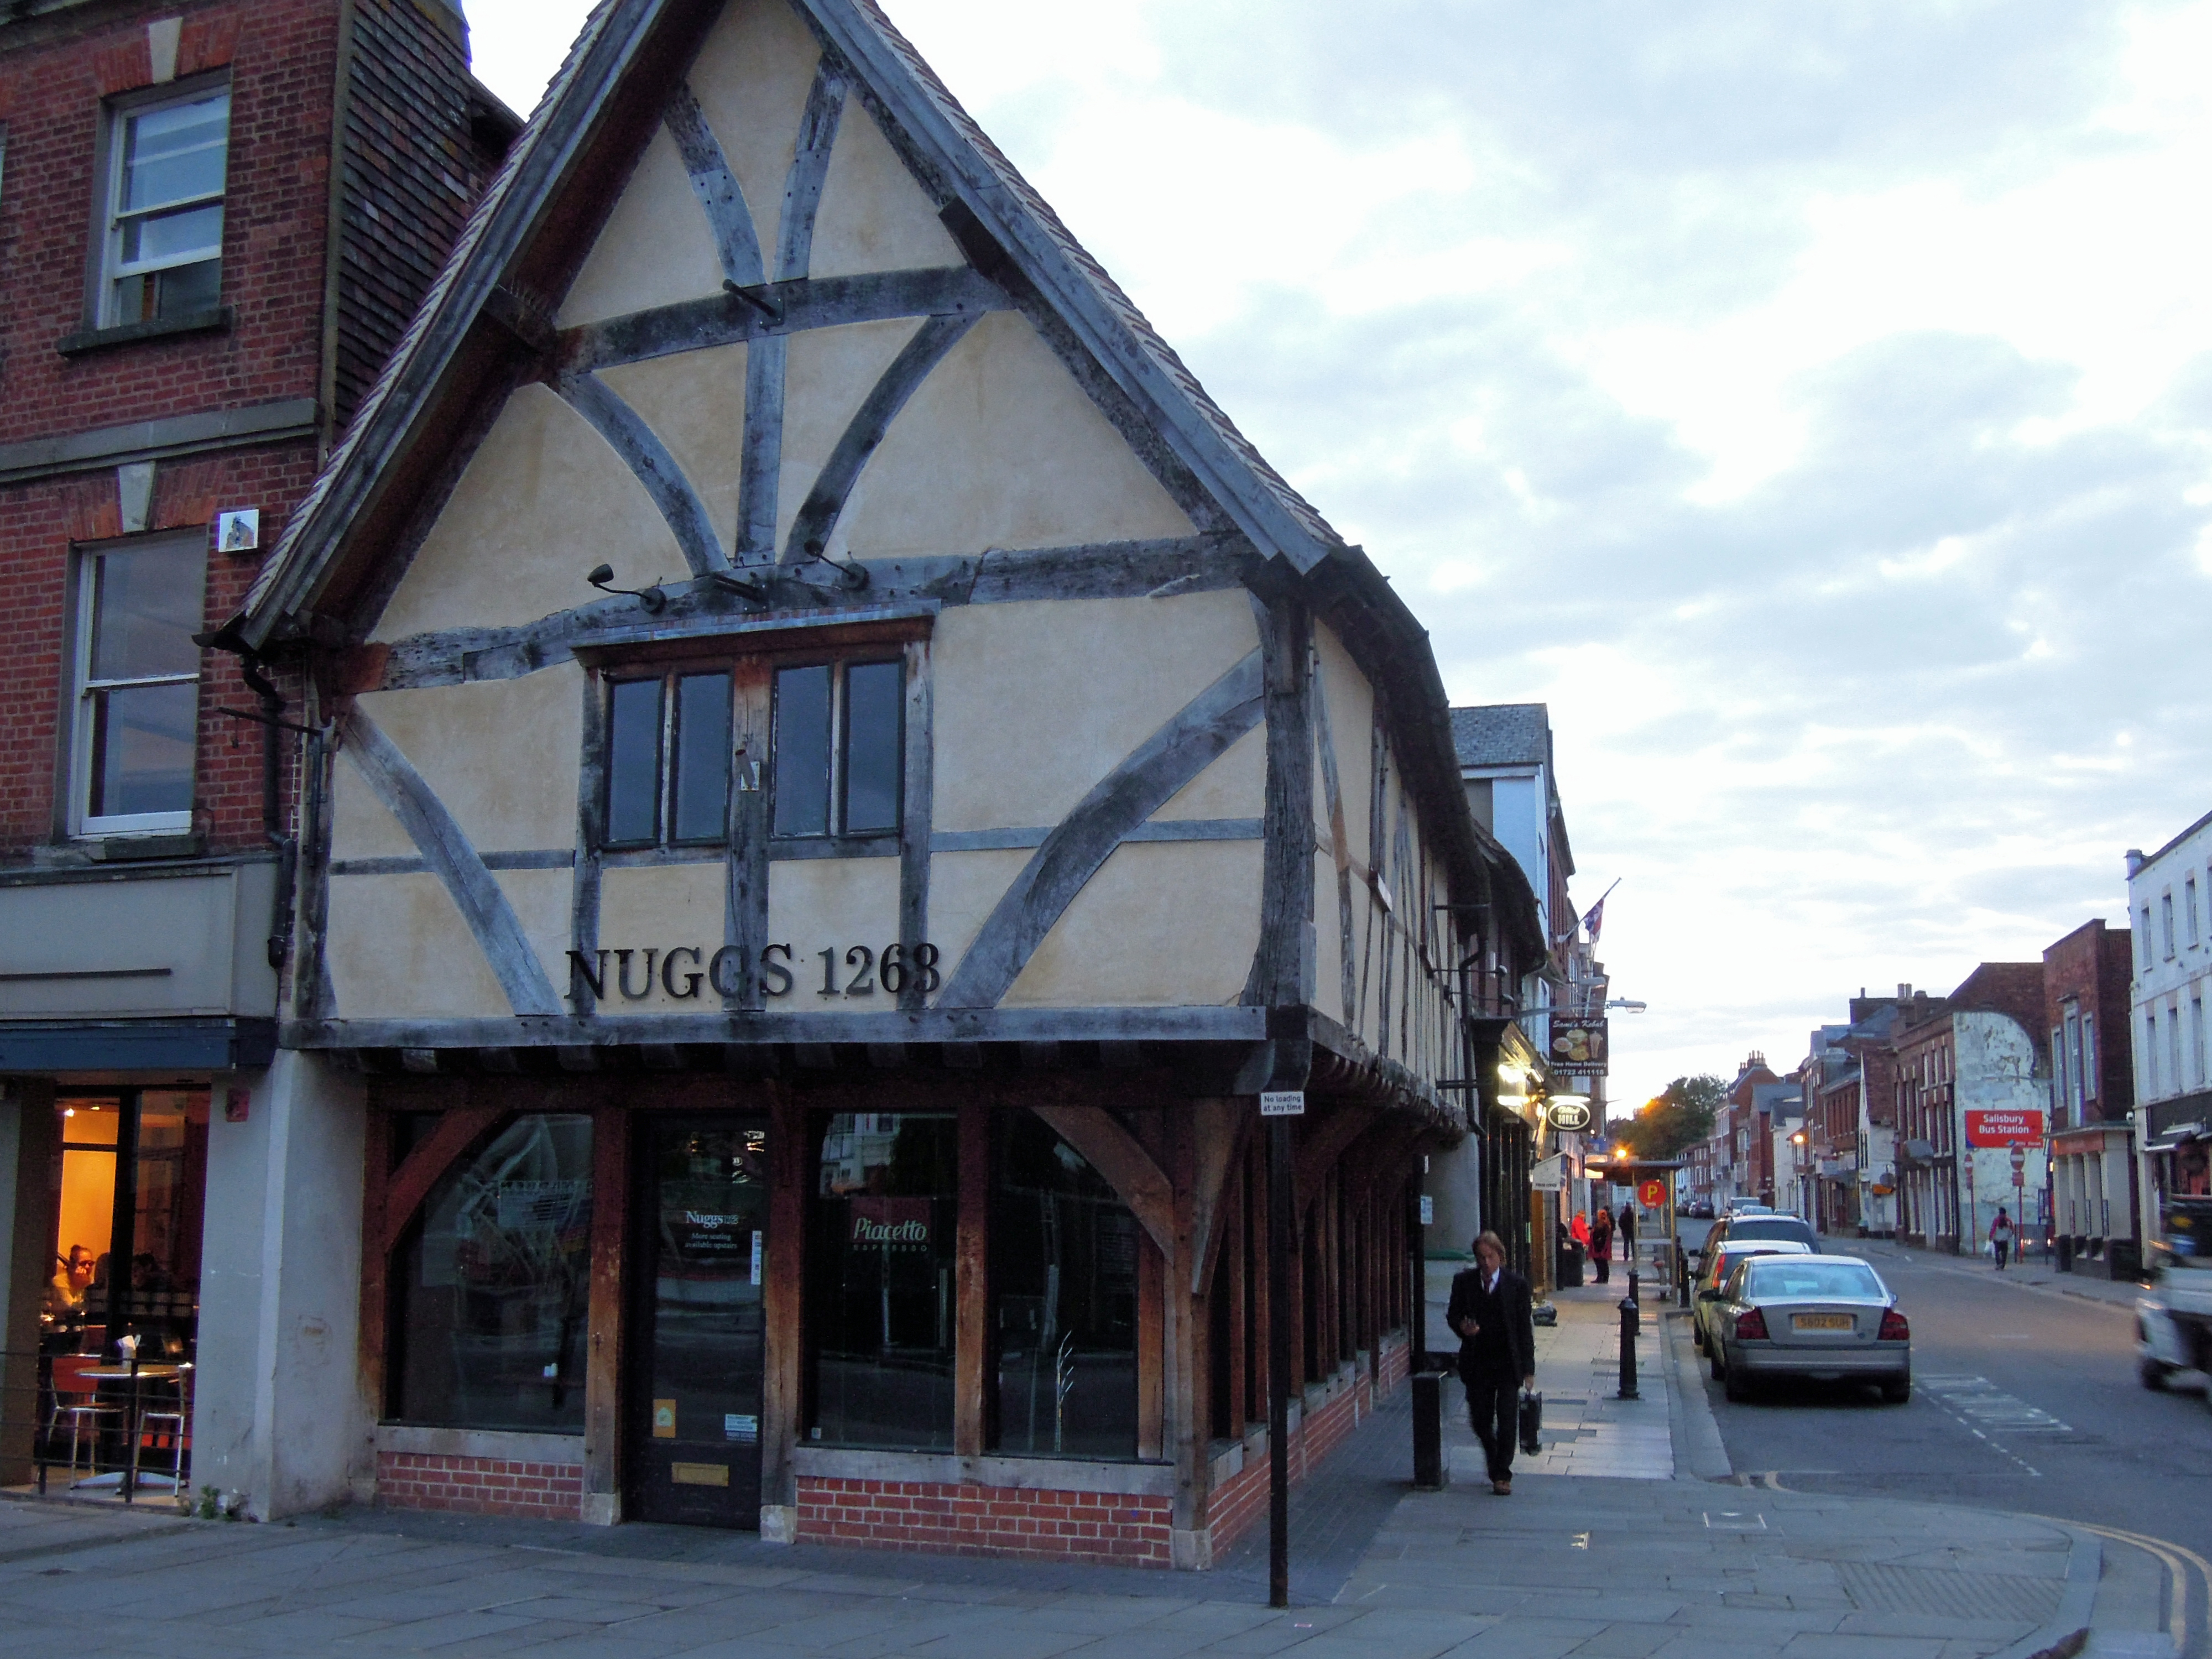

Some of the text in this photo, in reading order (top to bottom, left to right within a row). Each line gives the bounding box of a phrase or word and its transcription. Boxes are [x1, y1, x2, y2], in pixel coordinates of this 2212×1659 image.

[564, 942, 941, 999] NUGGS 1268
[1558, 1114, 1580, 1125] HILL
[1984, 1114, 2023, 1124] Salisbury
[1979, 1125, 2029, 1134] Bus Station
[1647, 1185, 1658, 1199] P
[685, 1211, 723, 1228] Nuggs
[853, 1217, 927, 1240] Piacetto
